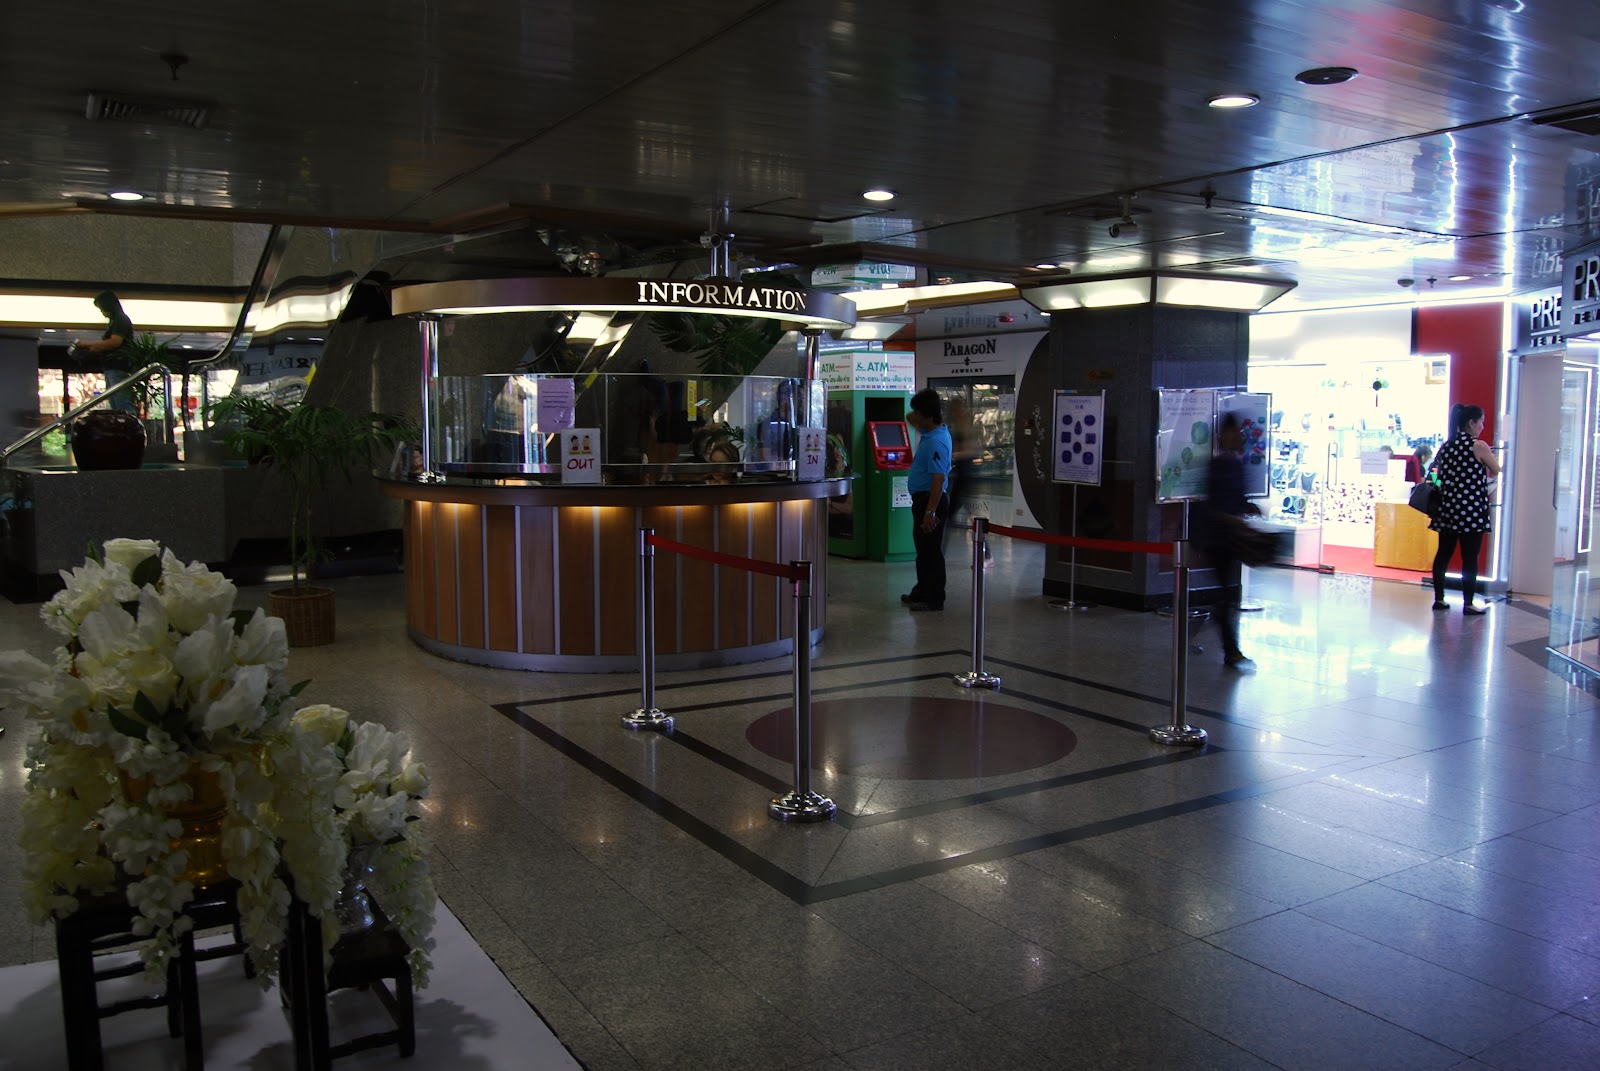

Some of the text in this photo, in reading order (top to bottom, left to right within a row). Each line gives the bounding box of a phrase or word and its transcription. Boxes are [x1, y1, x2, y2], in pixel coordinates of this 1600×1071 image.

[637, 281, 807, 311] INFORMATION
[1530, 292, 1562, 330] PRE
[943, 338, 997, 357] PARAGON
[821, 362, 835, 373] ATM
[867, 361, 890, 372] ATM
[567, 458, 595, 470] OUT
[807, 454, 819, 465] IN
